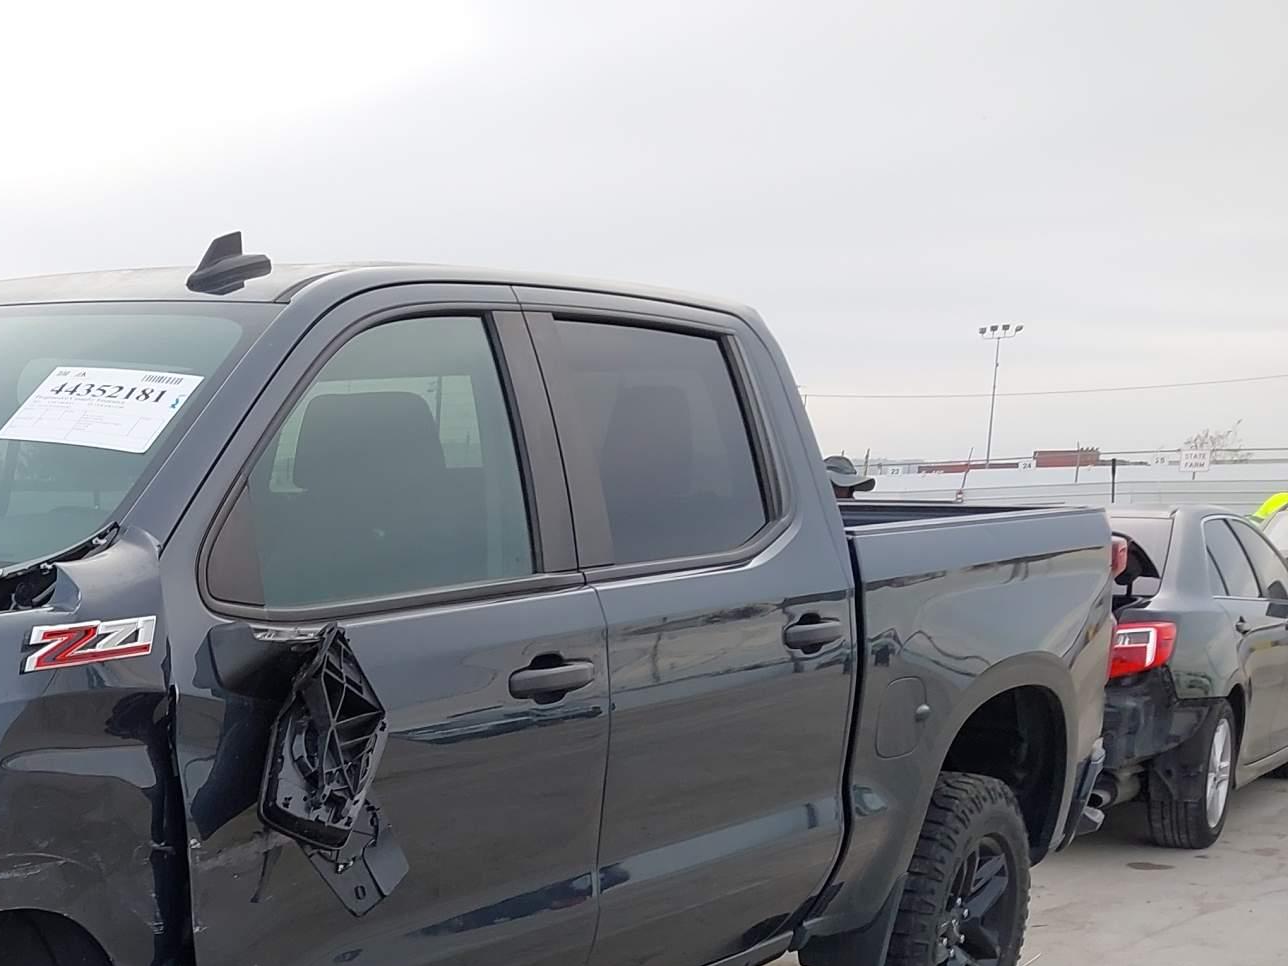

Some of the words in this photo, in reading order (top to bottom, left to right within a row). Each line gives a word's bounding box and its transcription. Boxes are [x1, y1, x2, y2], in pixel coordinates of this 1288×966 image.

[50, 382, 167, 403] 44352181
[1184, 452, 1207, 461] STATE
[1183, 461, 1206, 469] FARM
[24, 615, 157, 673] Z71
